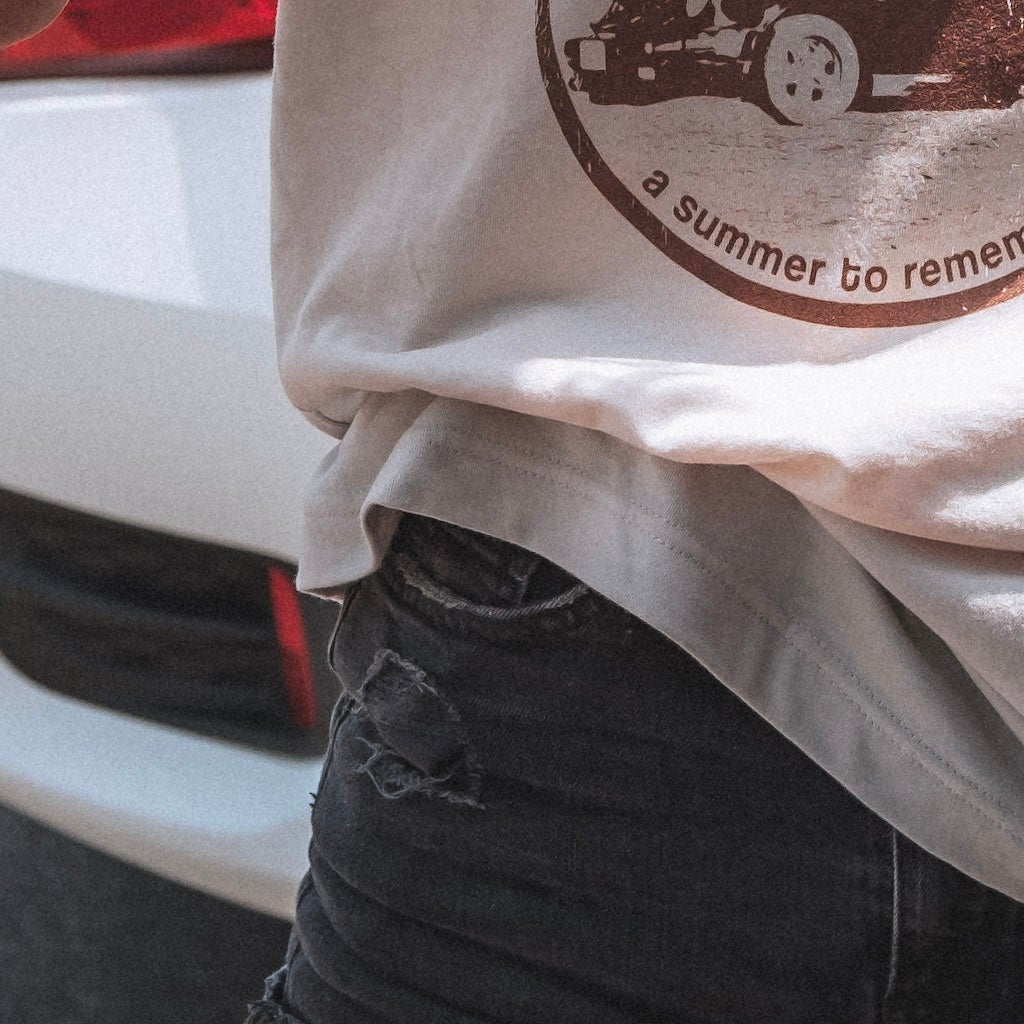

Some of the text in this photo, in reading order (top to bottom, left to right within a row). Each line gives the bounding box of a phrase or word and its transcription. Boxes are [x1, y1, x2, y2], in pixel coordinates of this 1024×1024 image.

[641, 169, 670, 198] a
[673, 194, 826, 286] summer
[841, 257, 888, 293] to
